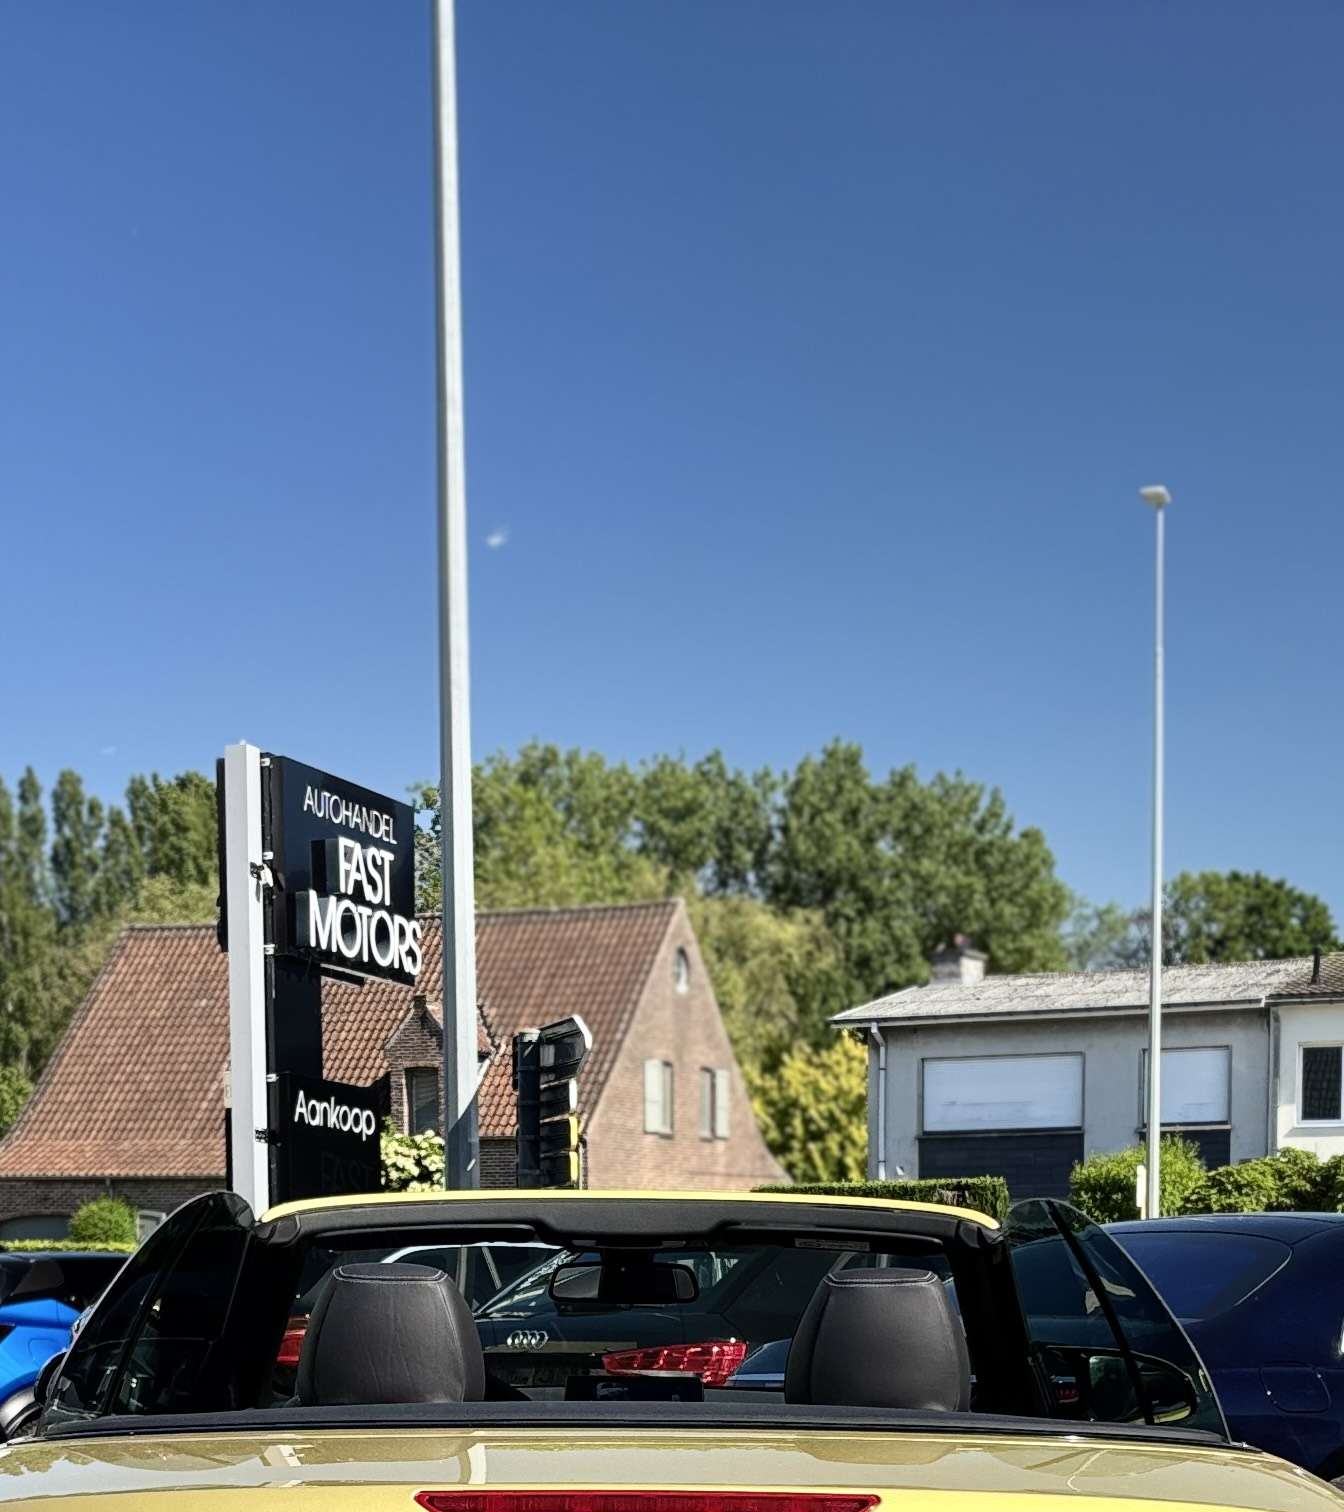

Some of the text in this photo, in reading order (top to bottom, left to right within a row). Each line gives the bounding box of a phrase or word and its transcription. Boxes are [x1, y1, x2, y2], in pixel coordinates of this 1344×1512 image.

[304, 786, 398, 845] AUTOHANDEL
[338, 836, 395, 906] FAST
[309, 889, 423, 976] MOTORS
[294, 1089, 376, 1142] Aankoop
